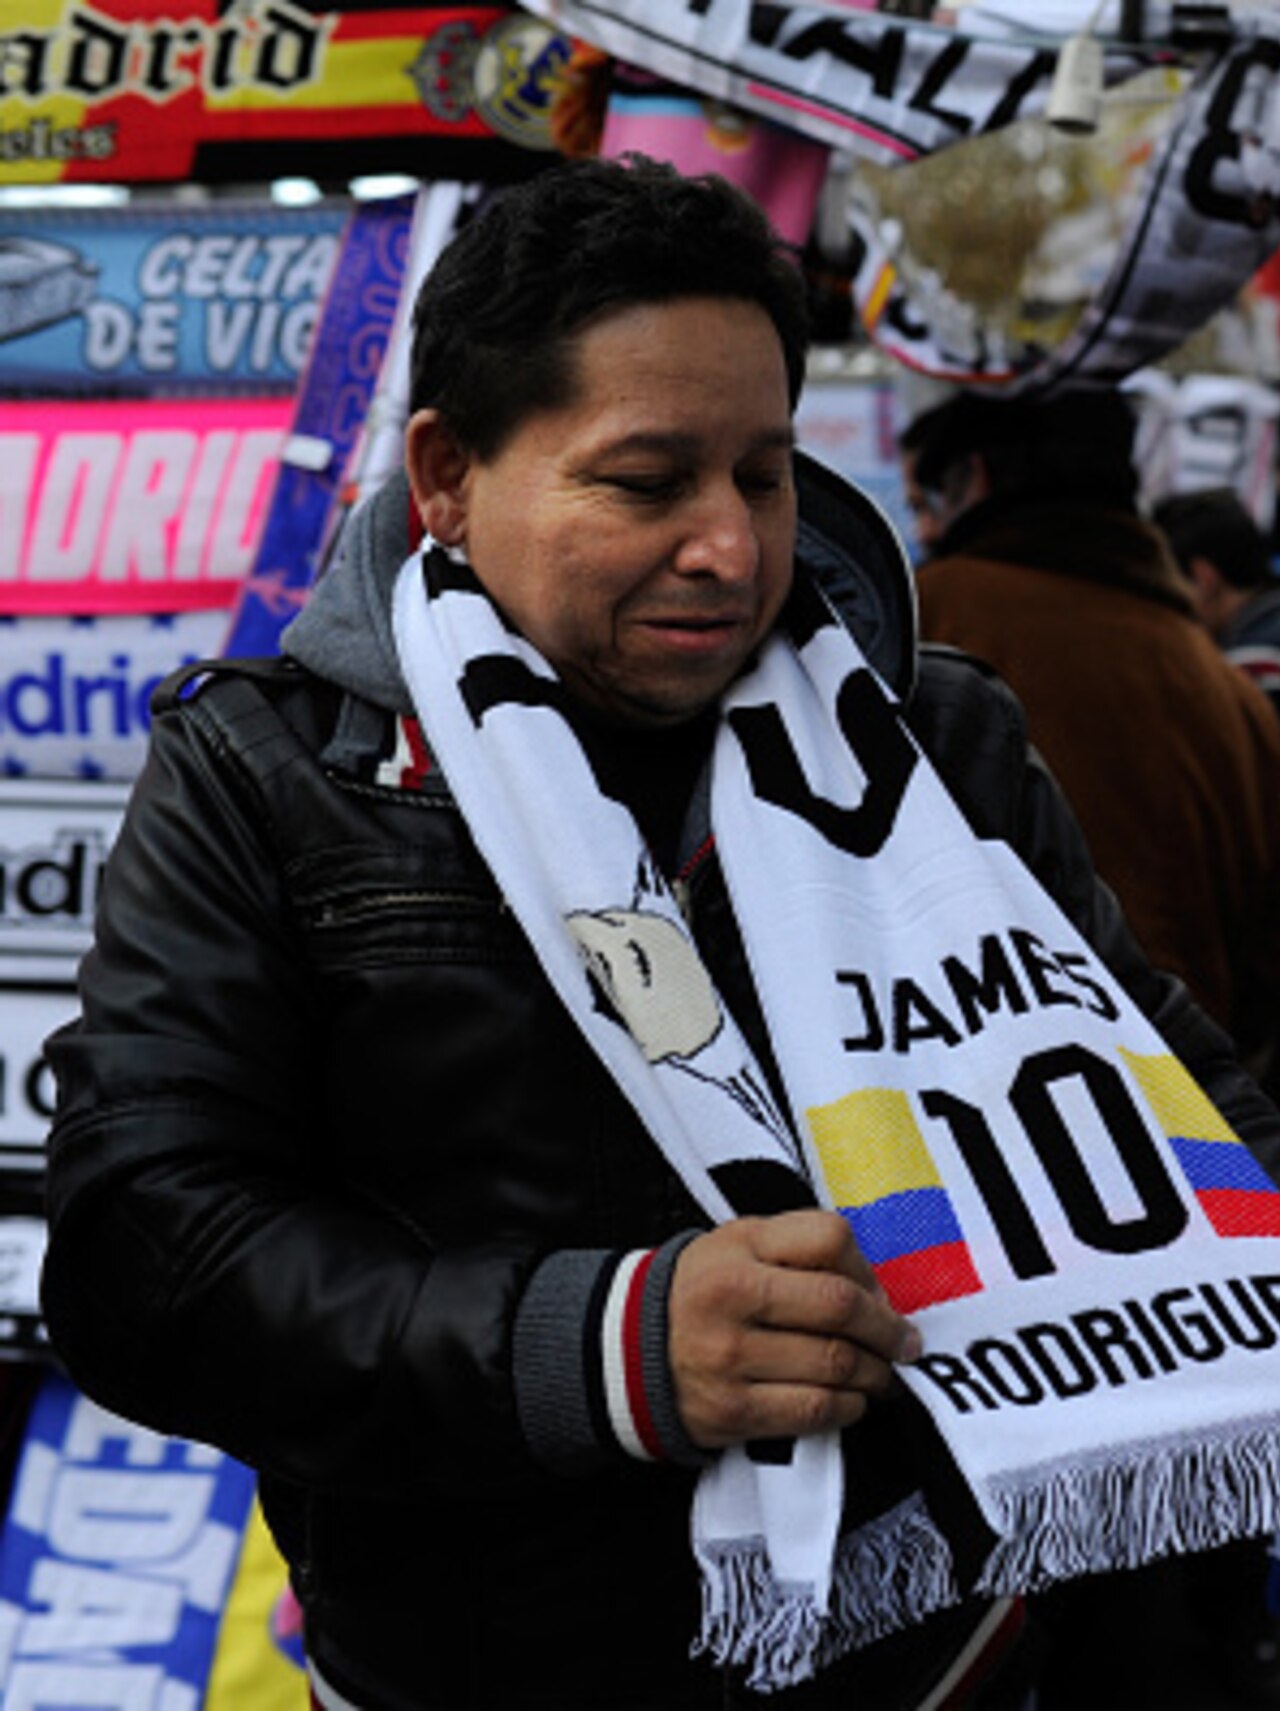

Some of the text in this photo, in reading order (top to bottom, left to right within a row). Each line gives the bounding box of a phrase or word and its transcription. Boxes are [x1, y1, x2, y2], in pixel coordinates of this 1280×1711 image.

[139, 234, 344, 300] CELTA
[85, 302, 181, 371] DE
[836, 928, 1121, 1053] JAMES
[916, 1042, 1190, 1281] 10
